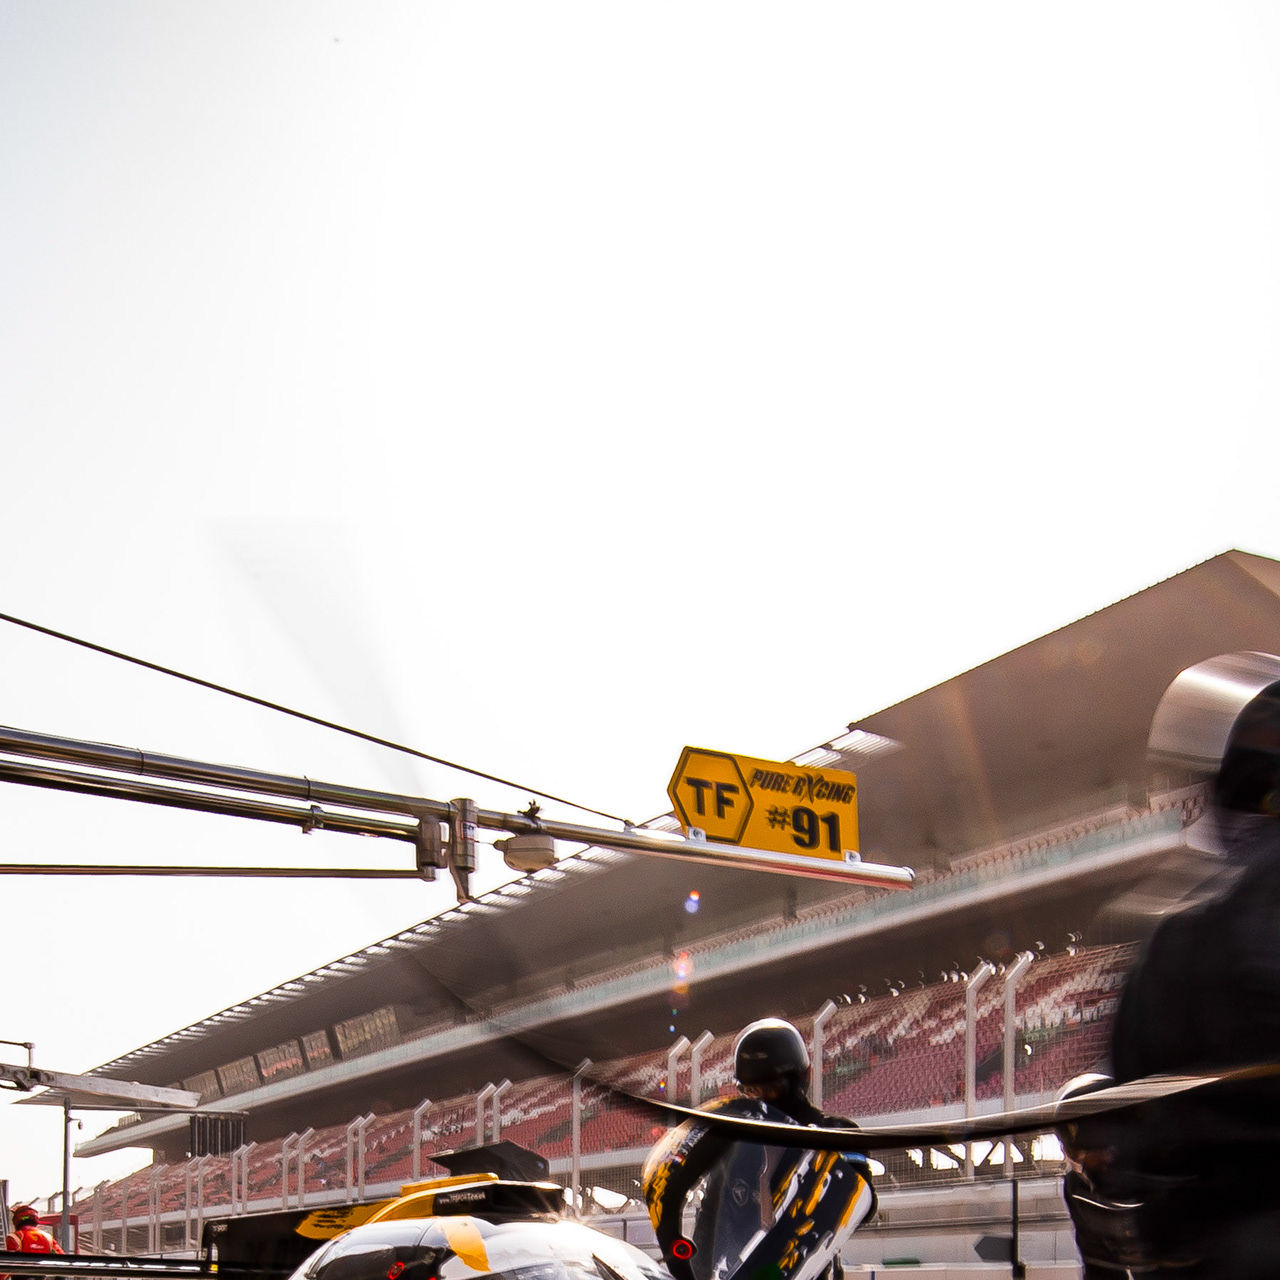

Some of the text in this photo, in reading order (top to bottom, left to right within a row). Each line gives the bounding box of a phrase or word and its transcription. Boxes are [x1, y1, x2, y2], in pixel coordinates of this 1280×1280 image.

[684, 776, 740, 820] TF
[749, 768, 792, 794] PURE
[765, 804, 841, 854] #91
